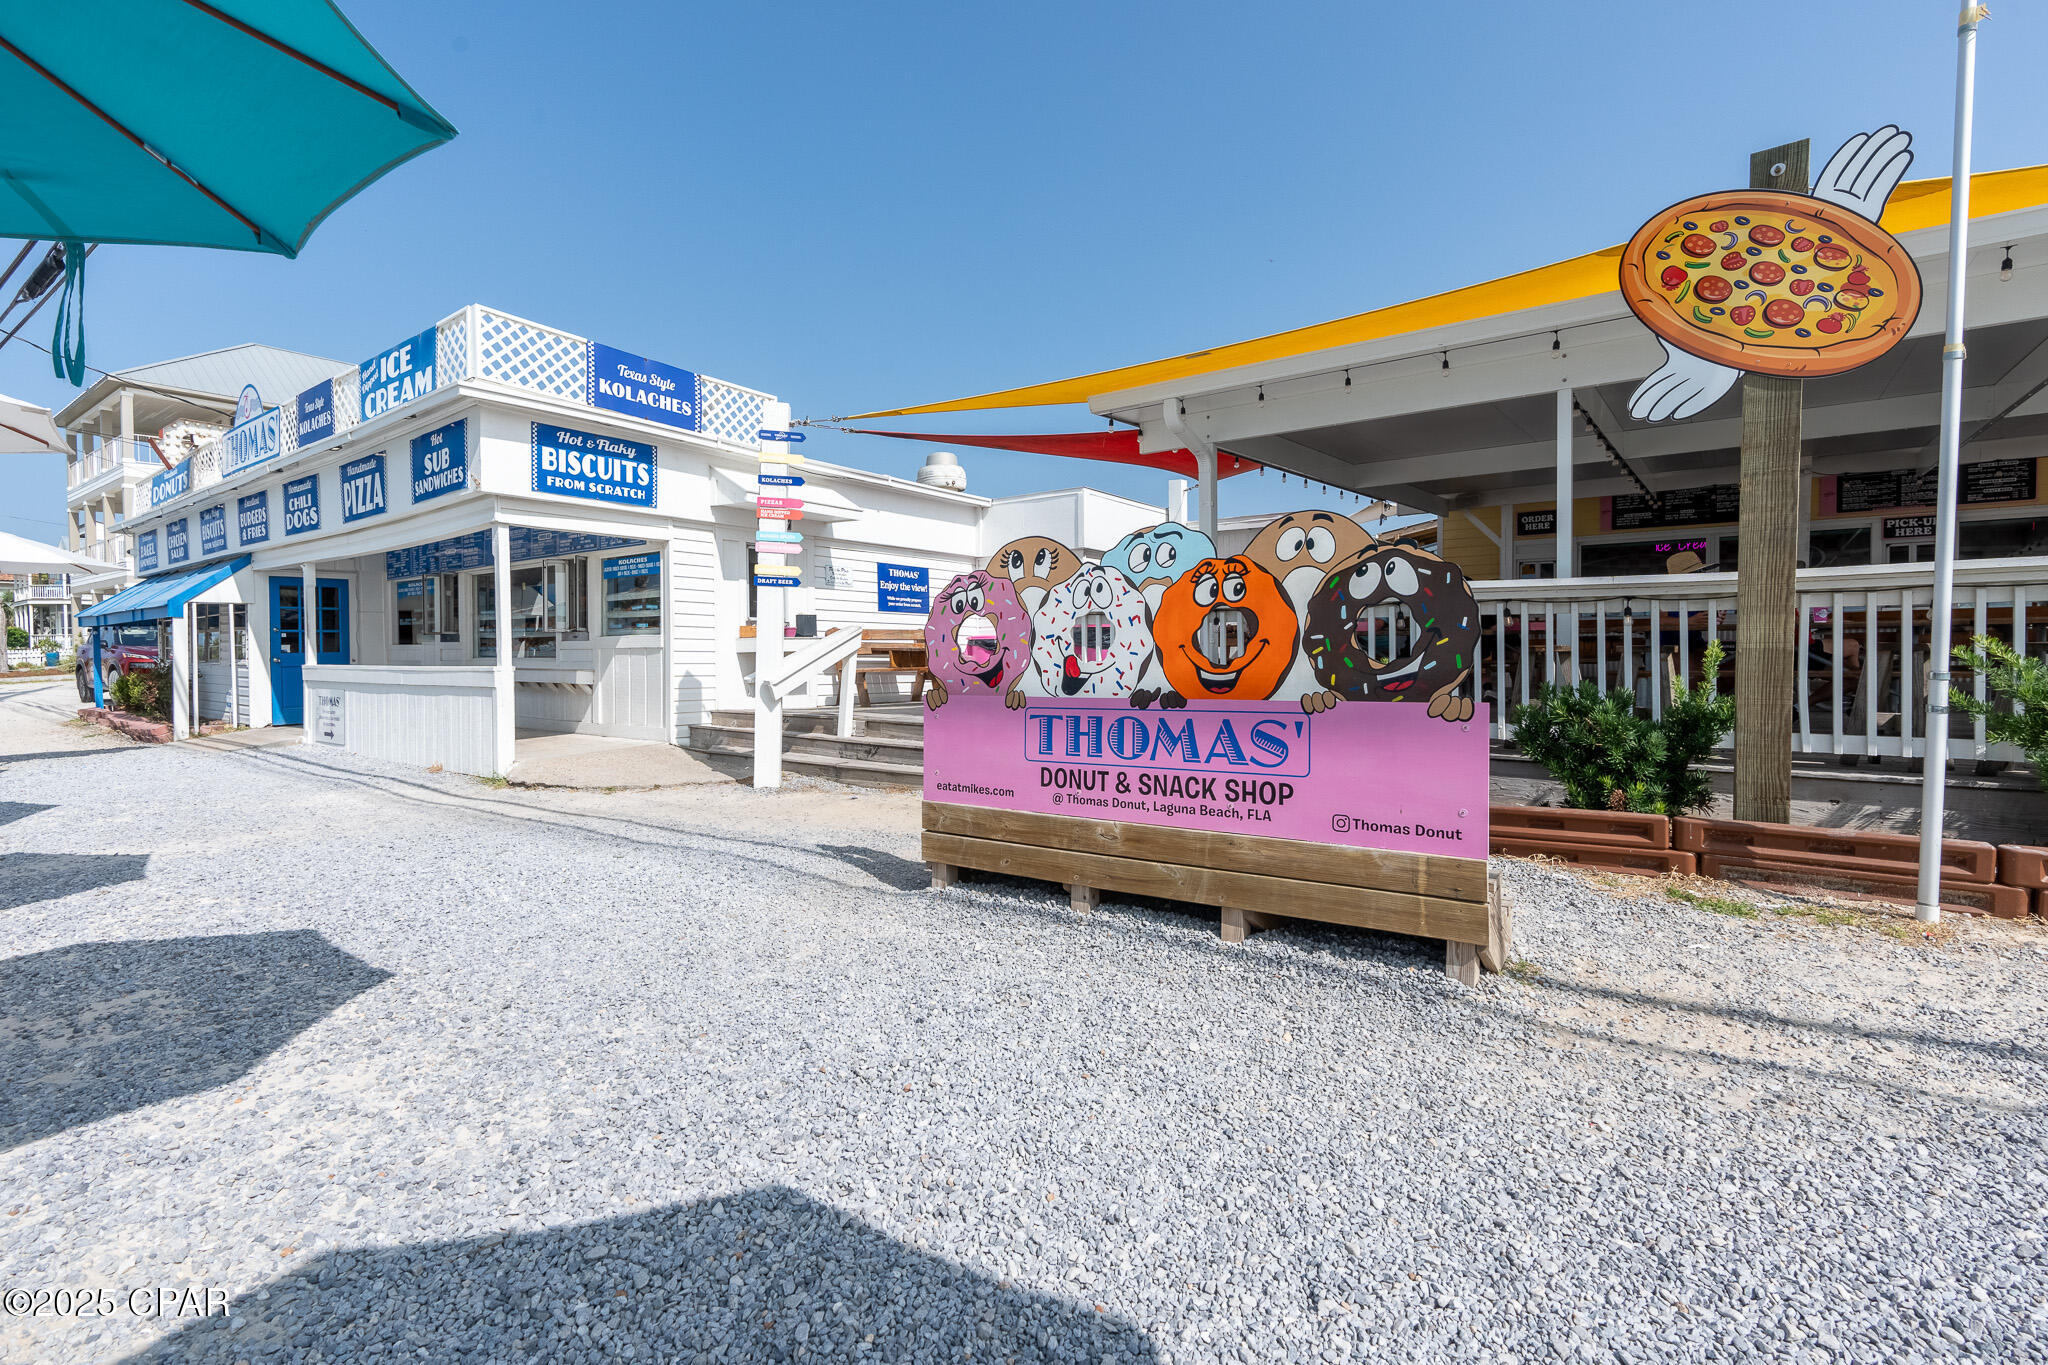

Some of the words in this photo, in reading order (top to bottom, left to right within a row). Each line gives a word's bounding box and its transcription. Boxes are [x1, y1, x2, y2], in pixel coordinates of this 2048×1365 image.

[380, 344, 412, 383] ICE
[617, 364, 647, 383] Texas
[649, 373, 676, 391] Style
[364, 365, 433, 419] CREAM
[599, 378, 692, 416] KOLACHES
[299, 410, 331, 436] KOLACHES
[430, 432, 443, 446] Hot
[556, 431, 584, 446] Hot
[586, 439, 595, 449] &
[596, 438, 637, 458] Flaky
[347, 458, 377, 476] Handmade
[424, 447, 450, 475] SUB
[541, 446, 650, 486] BISCUITS
[153, 471, 188, 503] DONUTS
[414, 466, 464, 496] SANDWICHES
[546, 476, 585, 491] FROM
[588, 482, 646, 500] SCRATCH
[761, 477, 793, 485] KOLACHES
[289, 493, 312, 511] CHILI
[343, 472, 384, 517] PIZZA
[240, 507, 266, 528] BURGERS
[286, 507, 318, 530] DOGS
[1521, 514, 1554, 523] ORDER
[1525, 522, 1551, 531] HERE
[168, 532, 188, 549] CHICKEN
[202, 519, 224, 541] BISCUITS
[247, 524, 266, 539] FRIES
[1895, 526, 1932, 536] HERE
[140, 543, 155, 558] BAGEL
[170, 547, 184, 559] SALAD
[618, 557, 648, 565] KOLACHES
[888, 568, 920, 579] THOMAS'
[880, 580, 899, 592] Enjoy
[899, 582, 911, 591] the
[911, 583, 928, 593] view!
[1029, 714, 1304, 768] THOMAS'
[936, 781, 1015, 798] eatatmikes.com
[1040, 766, 1109, 792] DONUT
[1115, 771, 1132, 794] &
[1138, 773, 1217, 802] SNACK
[1224, 778, 1294, 806] SHOP
[1052, 793, 1064, 806] @
[1066, 793, 1109, 809] Thomas
[1111, 797, 1150, 813] Donut,
[1153, 801, 1196, 817] Laguna
[1199, 804, 1243, 821] Beach,
[1247, 808, 1272, 822] FLA
[1353, 818, 1411, 835] Thomas
[1415, 824, 1463, 841] Donut
